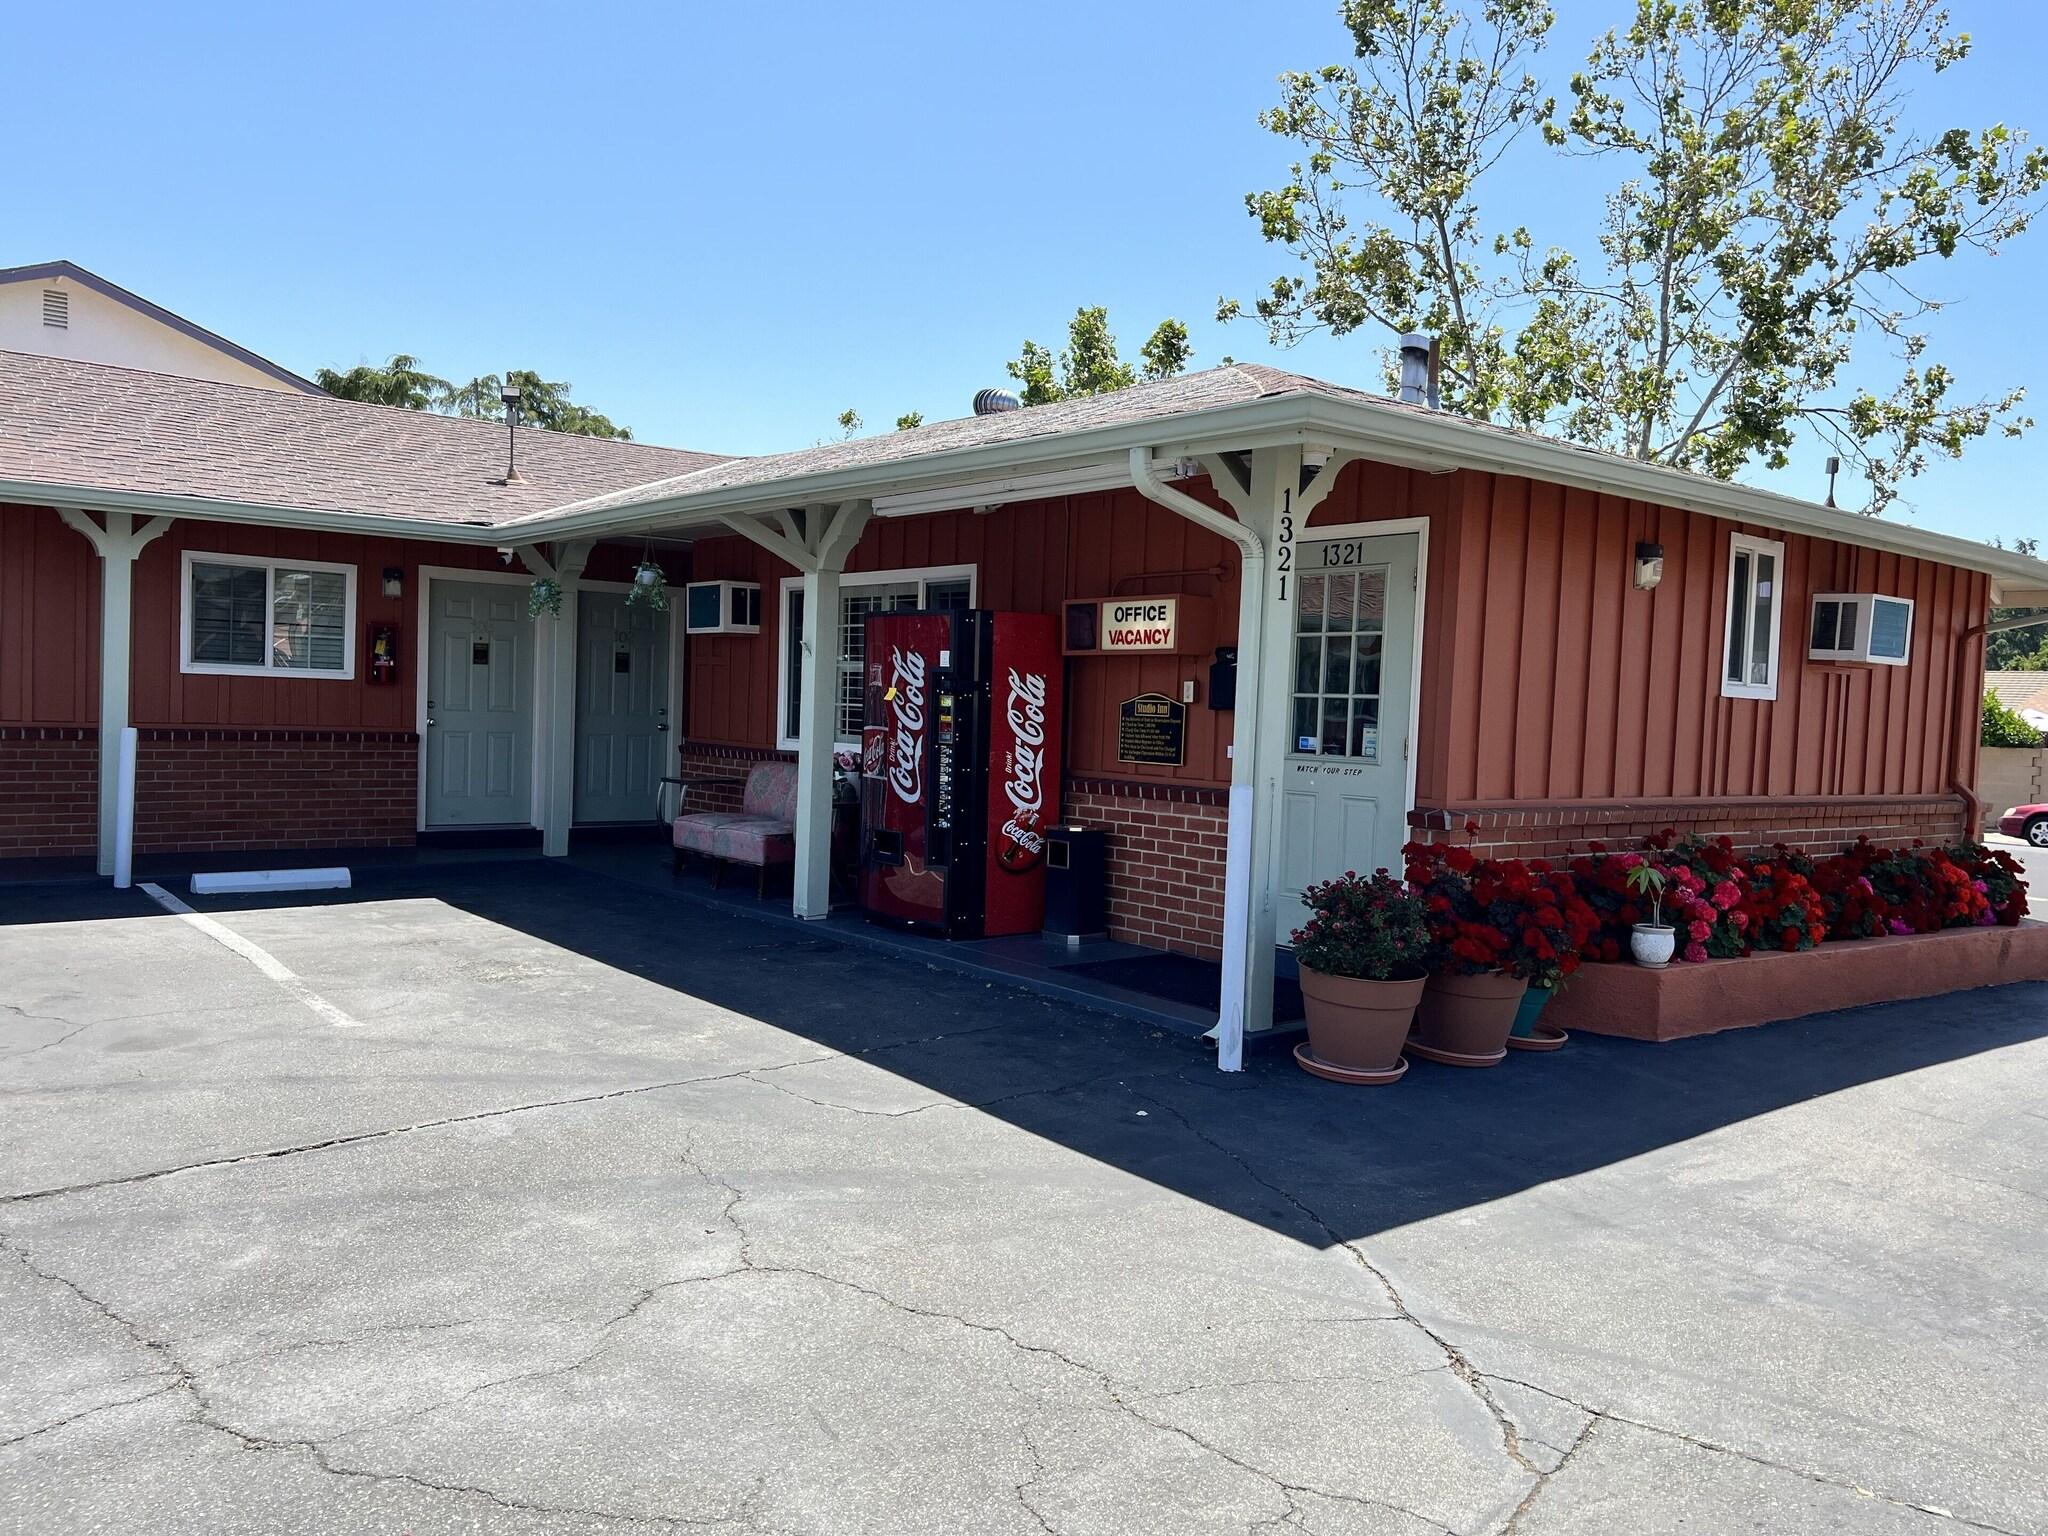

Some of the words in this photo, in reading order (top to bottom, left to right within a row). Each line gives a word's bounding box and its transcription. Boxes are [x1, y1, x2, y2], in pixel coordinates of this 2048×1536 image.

[1277, 488, 1293, 600] 1321
[1323, 542, 1363, 565] 1321
[1115, 606, 1167, 622] OFFICE
[1109, 629, 1170, 645] VACANCY
[1137, 703, 1156, 714] Studio
[1157, 703, 1168, 714] Inn
[889, 645, 925, 803] Coca-Cola
[1004, 667, 1046, 811] Coca-Cola
[1005, 751, 1013, 775] Drink!
[1297, 765, 1318, 773] WATCH
[1322, 767, 1341, 775] YOUR
[1343, 768, 1362, 776] STEP
[1001, 819, 1046, 855] Coca-Cola
